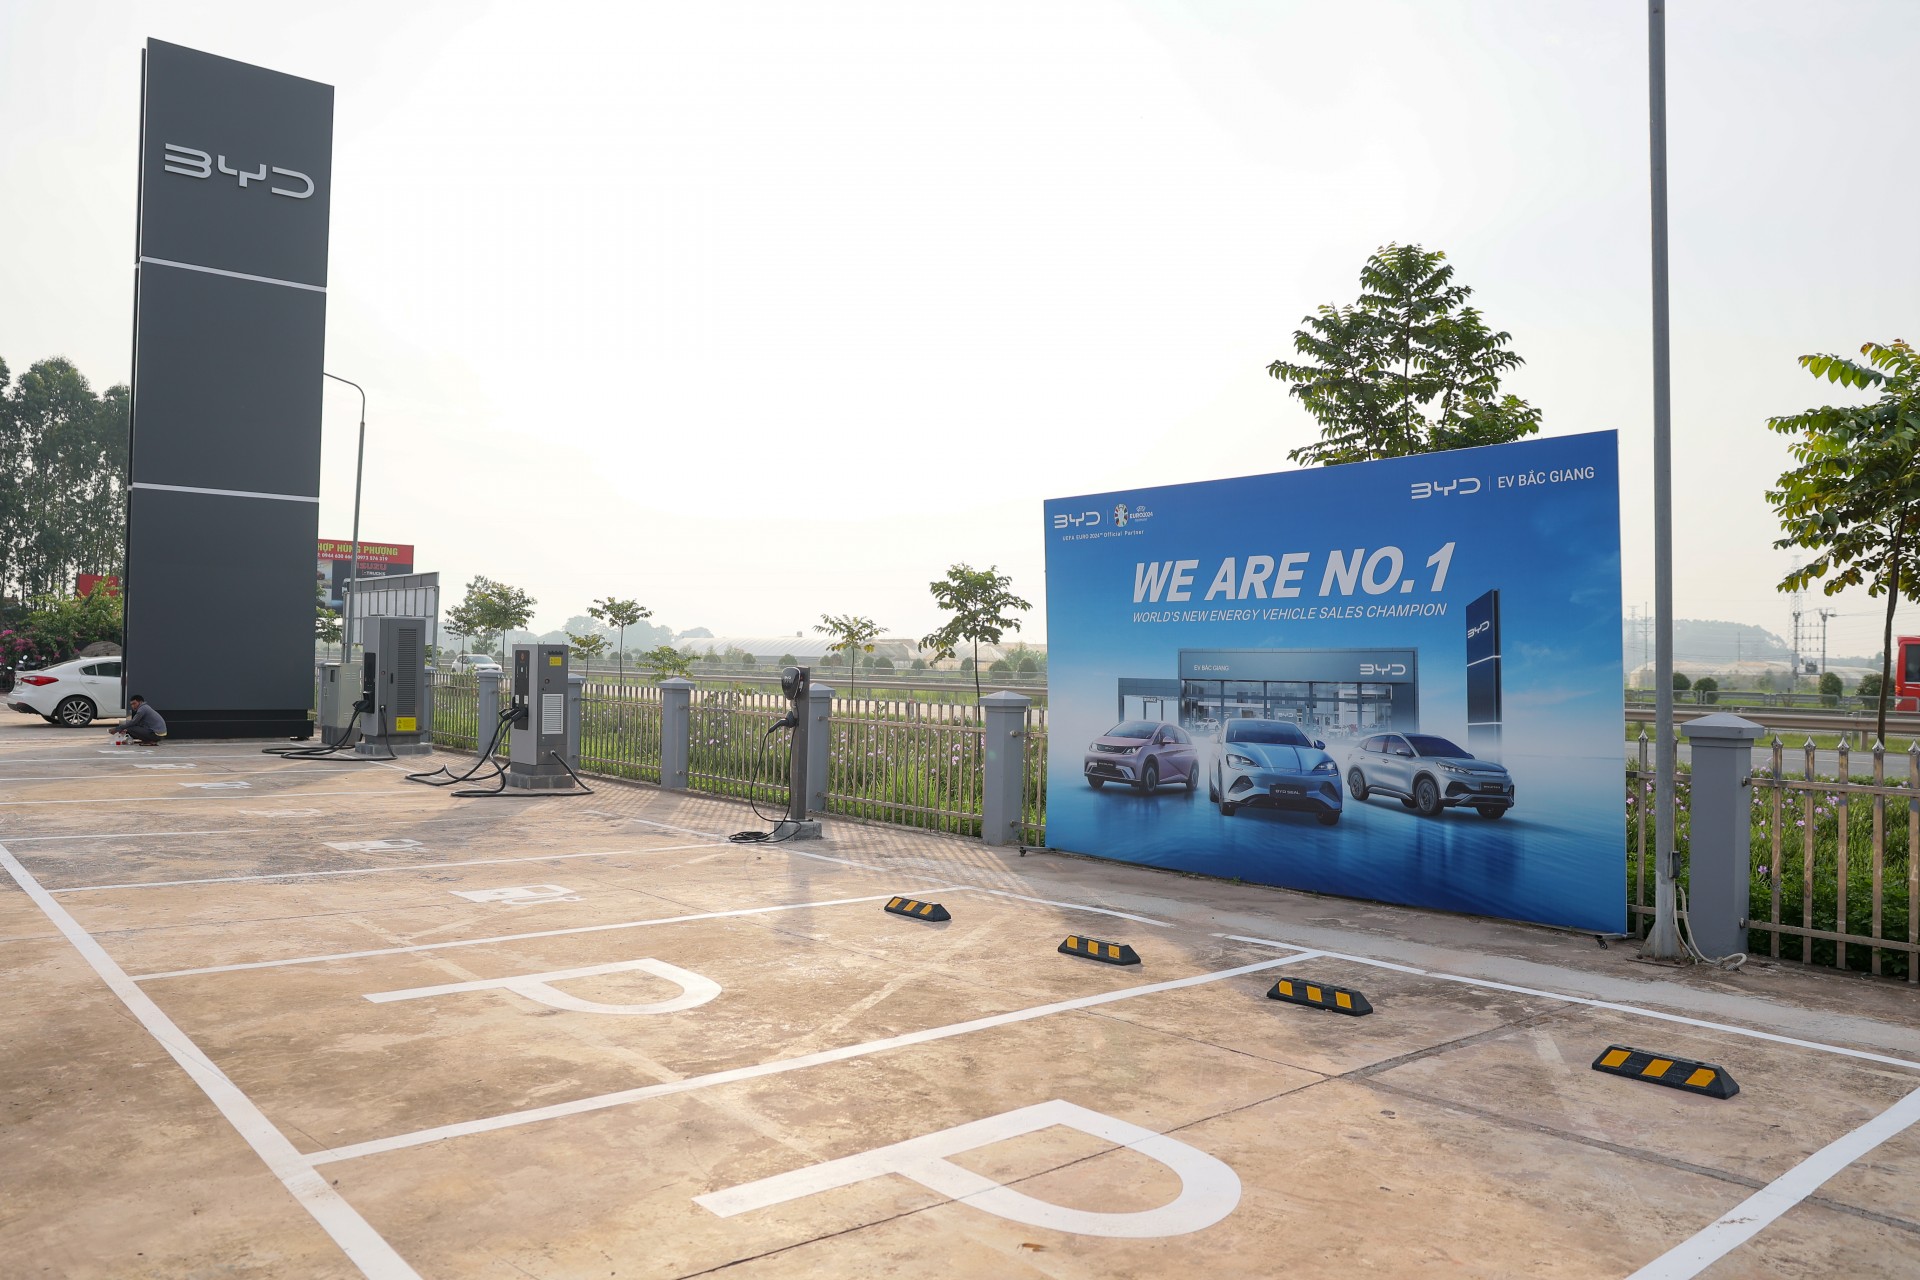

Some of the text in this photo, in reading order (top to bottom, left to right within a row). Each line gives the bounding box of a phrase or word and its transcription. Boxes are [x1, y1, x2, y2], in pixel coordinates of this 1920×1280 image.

[165, 143, 315, 199] BYD
[1411, 466, 1595, 500] BYD EV BẮC GIANG
[1054, 511, 1101, 529] BYD
[1103, 530, 1123, 538] Official
[1133, 559, 1200, 603] WE
[1203, 552, 1311, 601] ARE
[1133, 603, 1448, 623] WORLD'S NEW ENERGY VEHICLE SALES CHAMPION
[1467, 620, 1490, 639] BYD
[1359, 663, 1406, 676] BYD
[362, 958, 722, 1014] P
[691, 1098, 1241, 1238] P
